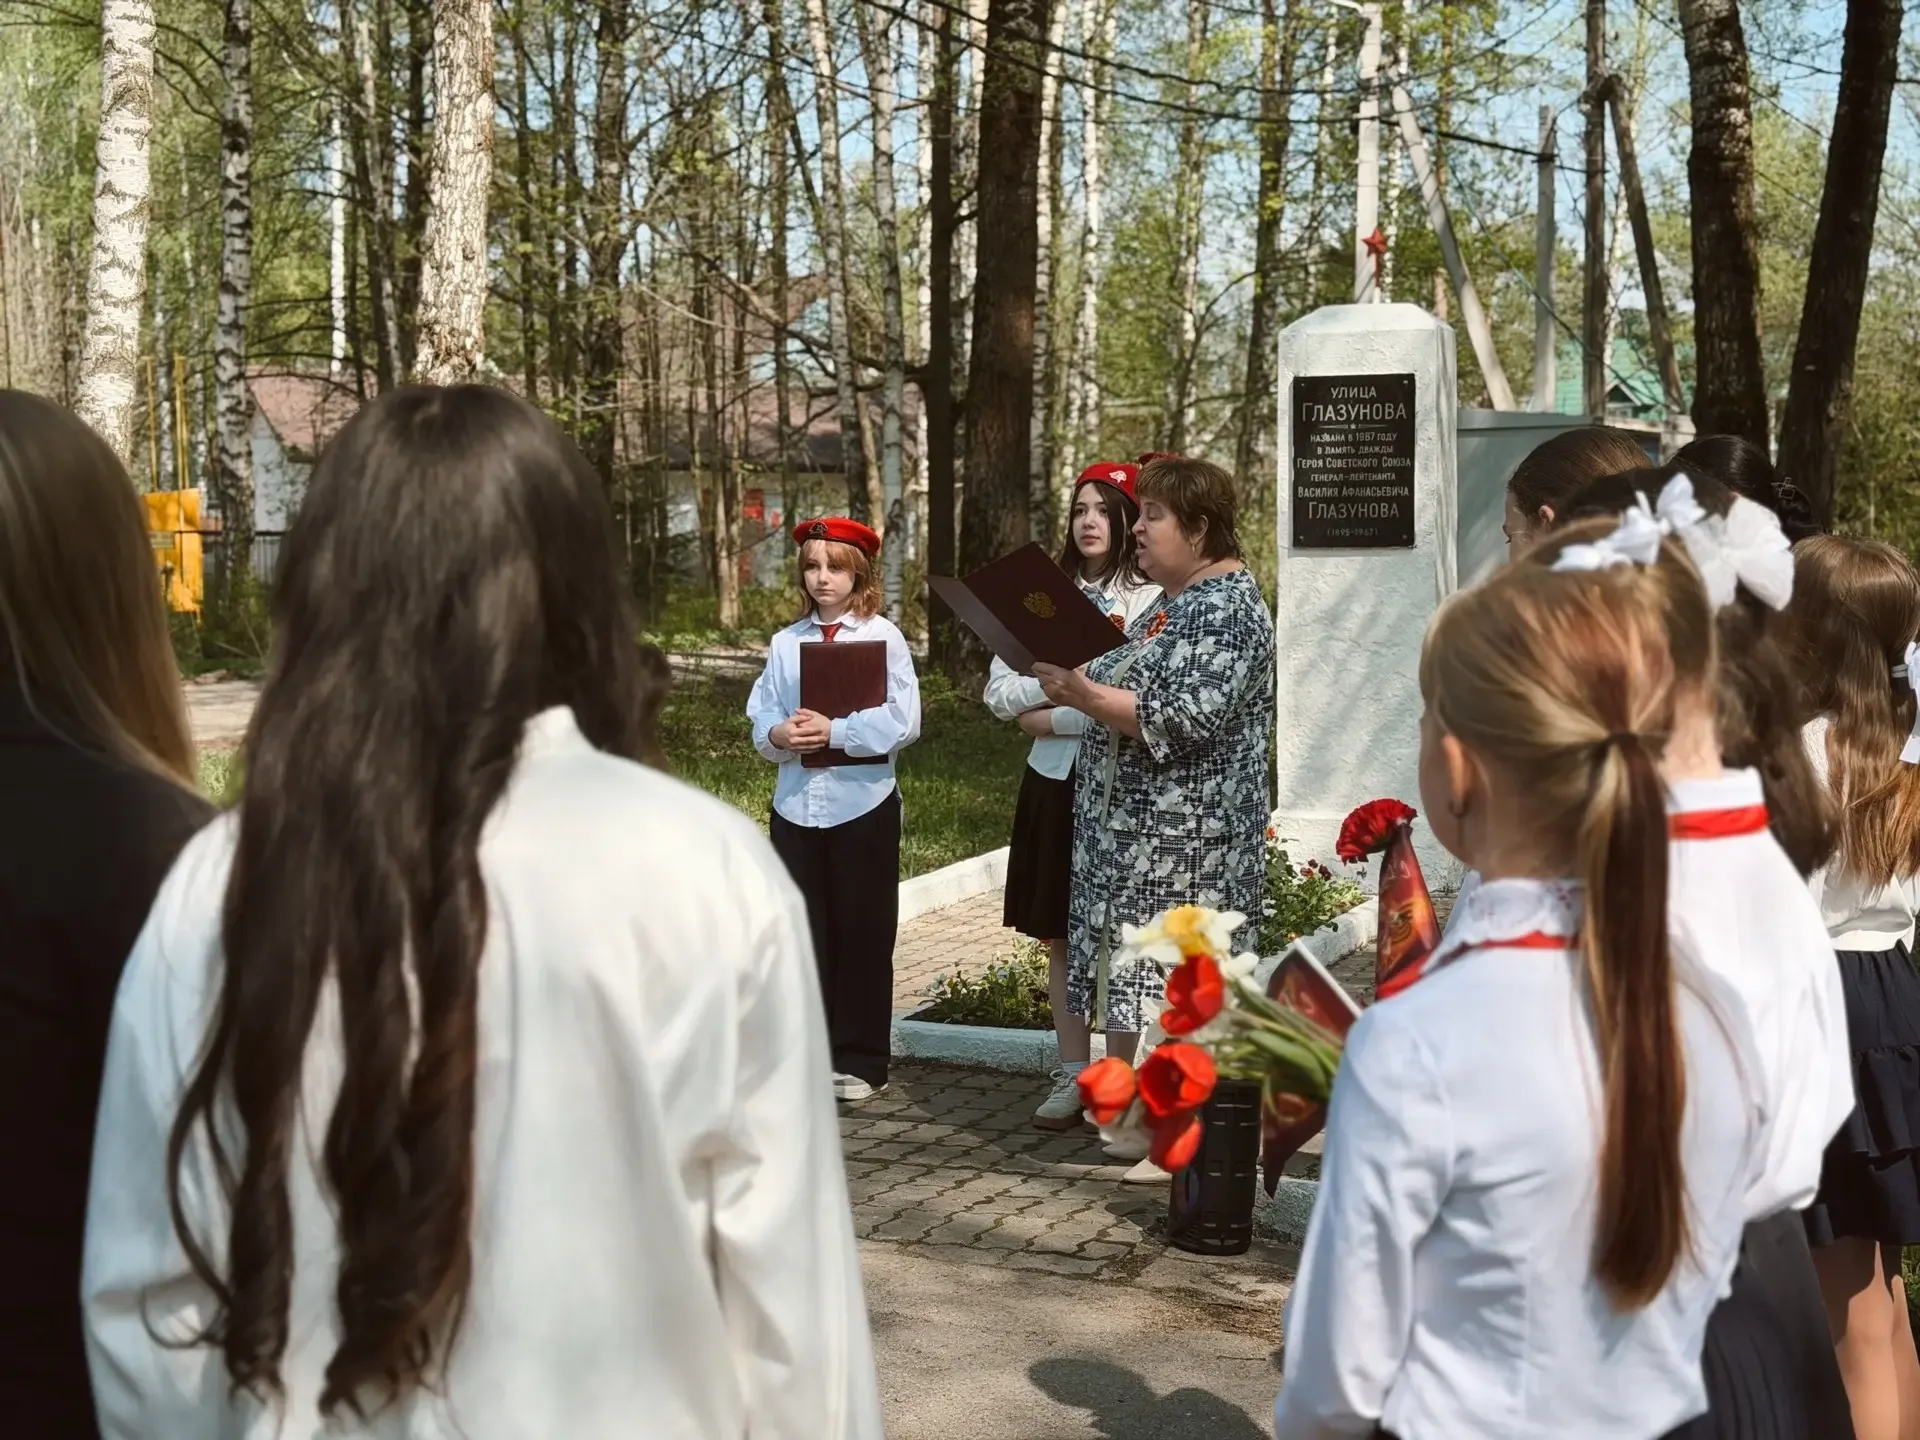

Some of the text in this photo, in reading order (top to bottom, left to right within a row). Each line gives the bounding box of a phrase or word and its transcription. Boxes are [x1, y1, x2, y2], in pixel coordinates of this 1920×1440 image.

[1331, 387, 1377, 399] УЛИЦА
[1302, 402, 1407, 422] ГЛАЗУНОВА
[1308, 501, 1400, 519] ГЛАЗУНОВА
